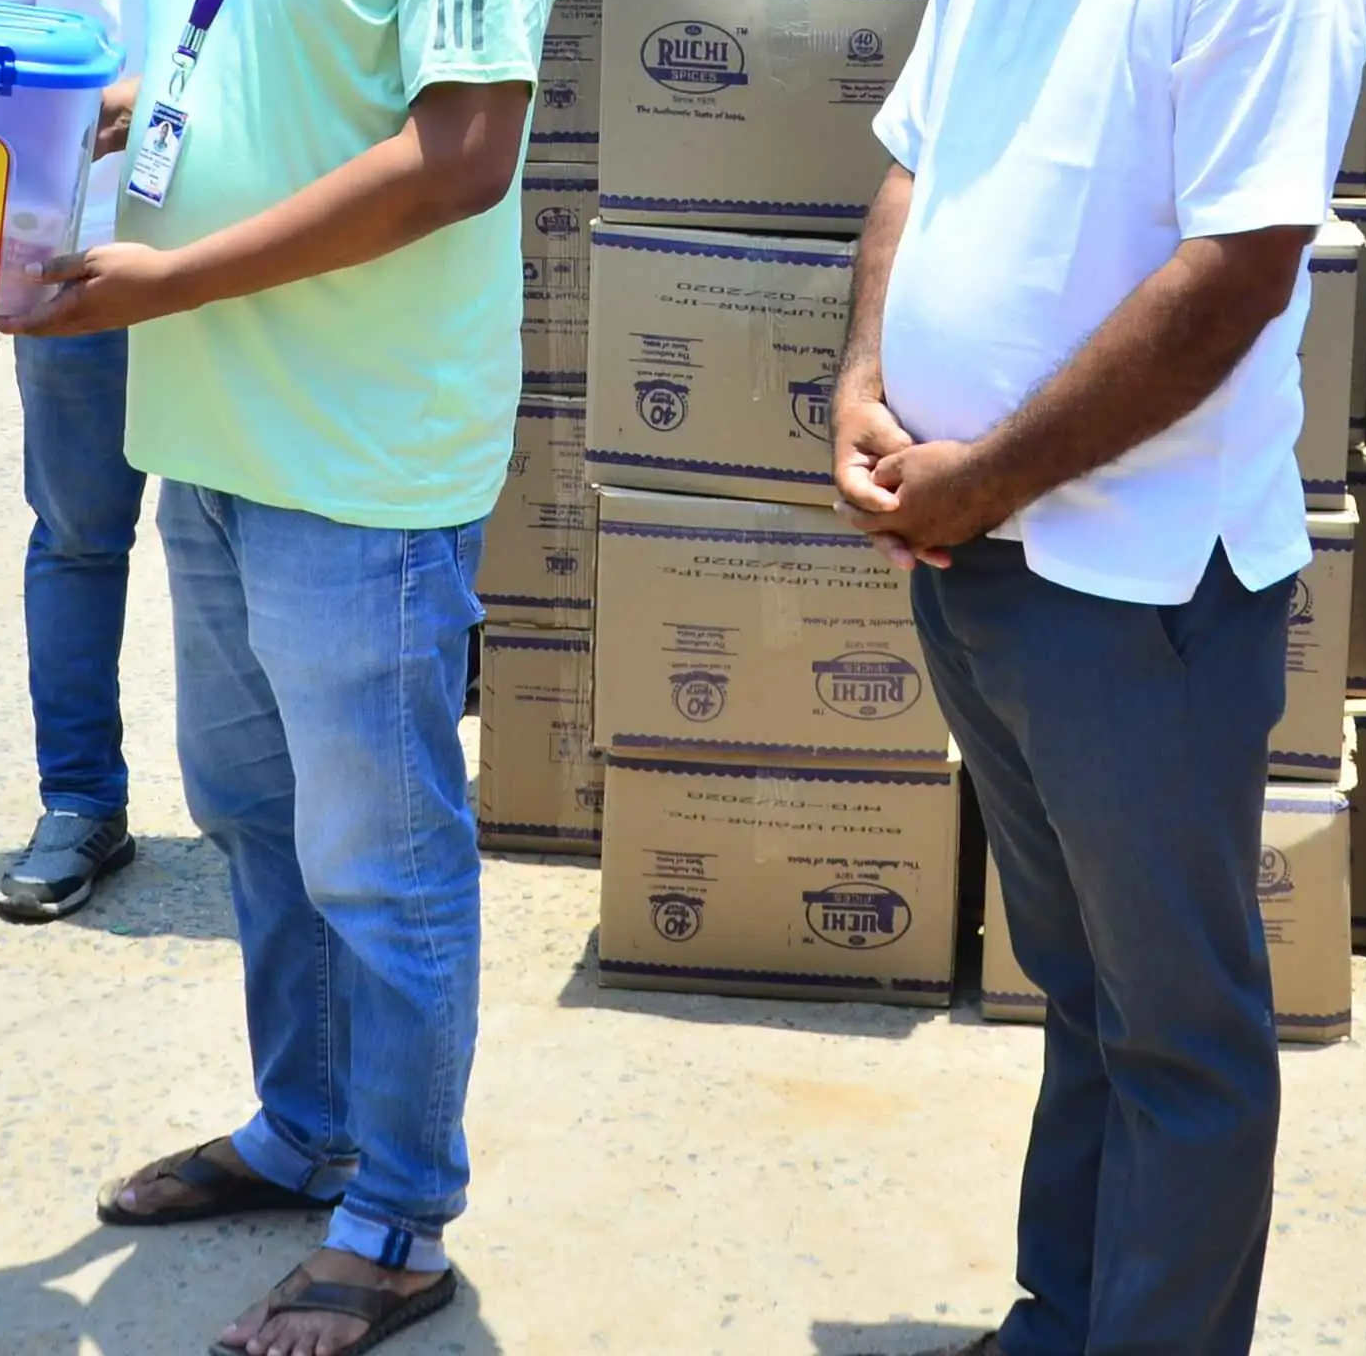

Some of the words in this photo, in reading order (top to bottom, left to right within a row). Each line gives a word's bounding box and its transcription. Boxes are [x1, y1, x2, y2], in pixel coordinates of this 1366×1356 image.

[854, 33, 874, 46] 40
[658, 37, 728, 70] RUCHI
[670, 70, 718, 83] SPICES
[636, 105, 651, 115] The
[653, 107, 690, 118] Authentic
[650, 405, 676, 425] 40
[832, 675, 904, 703] RUCHI
[687, 696, 715, 716] 40
[665, 916, 691, 937] 40
